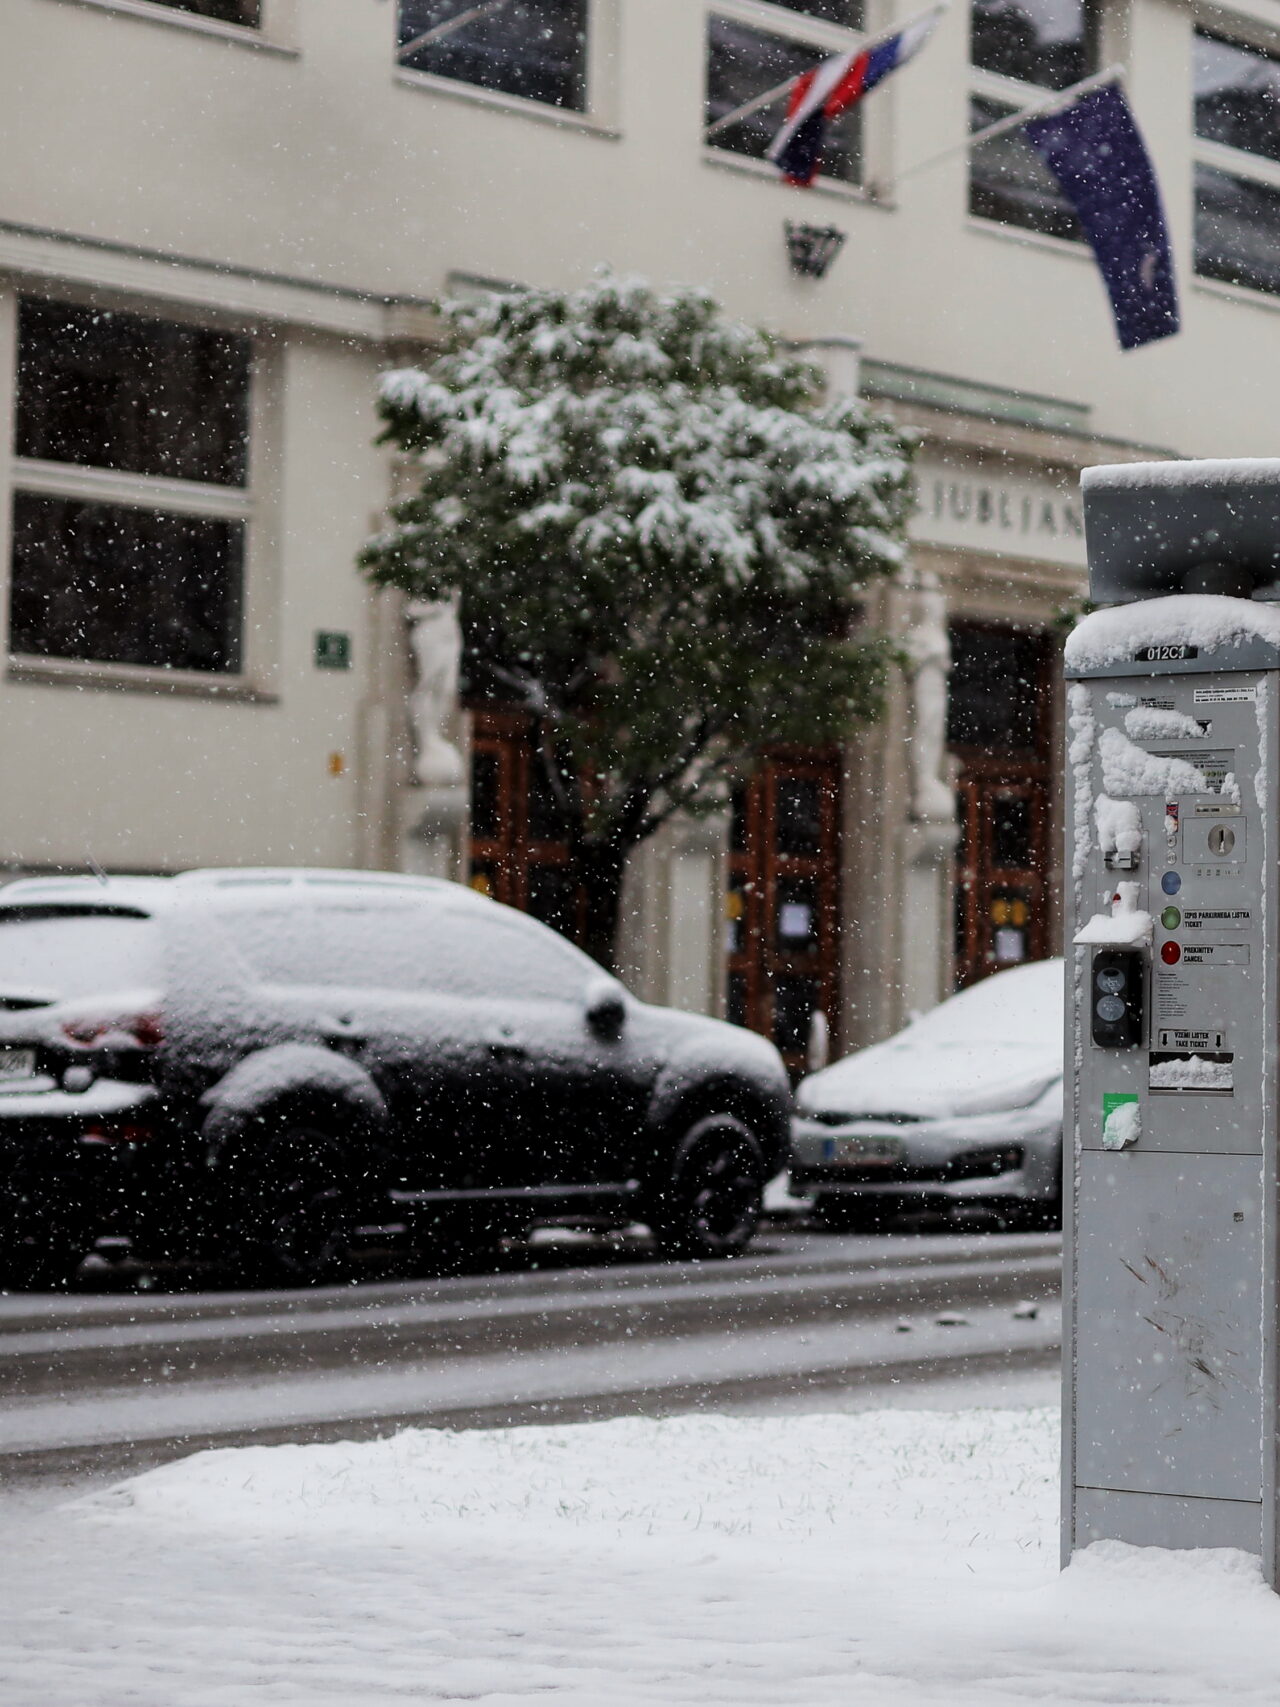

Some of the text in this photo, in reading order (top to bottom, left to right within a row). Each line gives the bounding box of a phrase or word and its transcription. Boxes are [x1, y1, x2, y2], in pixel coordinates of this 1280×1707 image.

[1147, 646, 1186, 660] 012C1
[1184, 911, 1198, 919] IZPIS
[1198, 911, 1231, 919] PARKIRNEGA
[1183, 955, 1204, 963] CANCEL
[1189, 1040, 1208, 1048] TICKET
